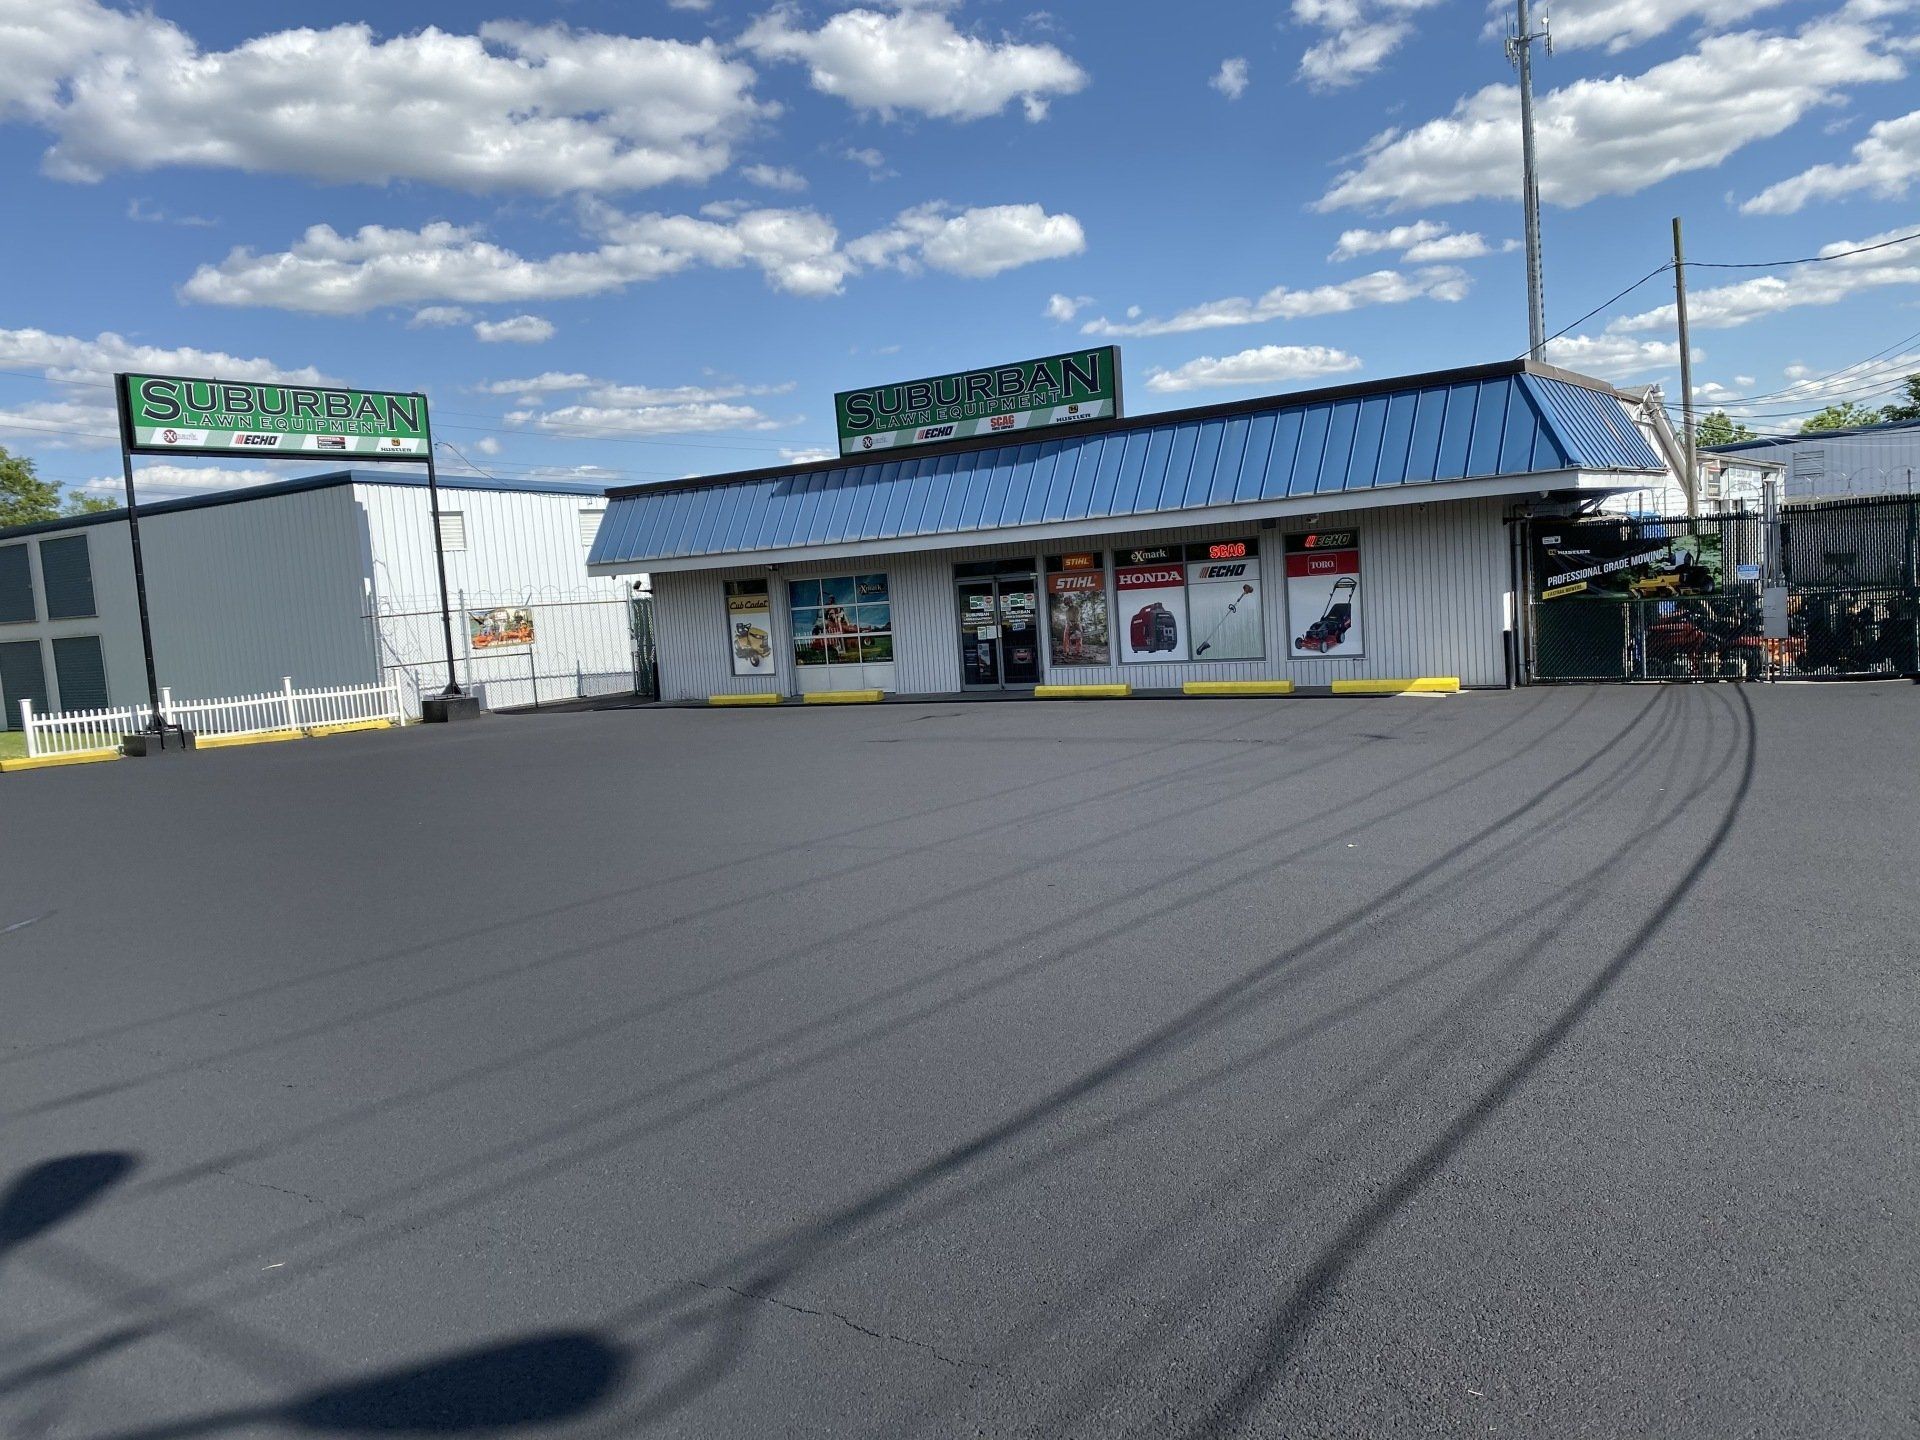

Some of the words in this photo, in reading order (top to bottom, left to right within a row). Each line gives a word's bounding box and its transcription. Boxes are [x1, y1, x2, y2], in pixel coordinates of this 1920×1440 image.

[846, 353, 1101, 430] SUBURBAN
[140, 379, 420, 433] SUBURBAN
[876, 409, 932, 429] LAWN
[936, 389, 1061, 421] EQUIPMENT
[183, 412, 253, 429] LAWN
[259, 416, 387, 434] EQUIPMENT
[990, 415, 1015, 427] SCAG
[243, 434, 279, 446] ECHO
[924, 426, 954, 439] ECHO
[1314, 533, 1350, 547] ECHO
[1209, 543, 1246, 559] SCAG
[1064, 556, 1090, 567] STIHL
[1310, 559, 1335, 569] TORO
[1547, 565, 1602, 587] PROFESSIONAL
[1603, 557, 1630, 573] GRADE
[1630, 548, 1664, 566] MOWING
[1119, 570, 1182, 586] HONDA
[1207, 563, 1247, 579] ECHO
[1055, 575, 1096, 590] STIHL
[729, 600, 744, 610] Cub
[744, 599, 768, 609] Cadet
